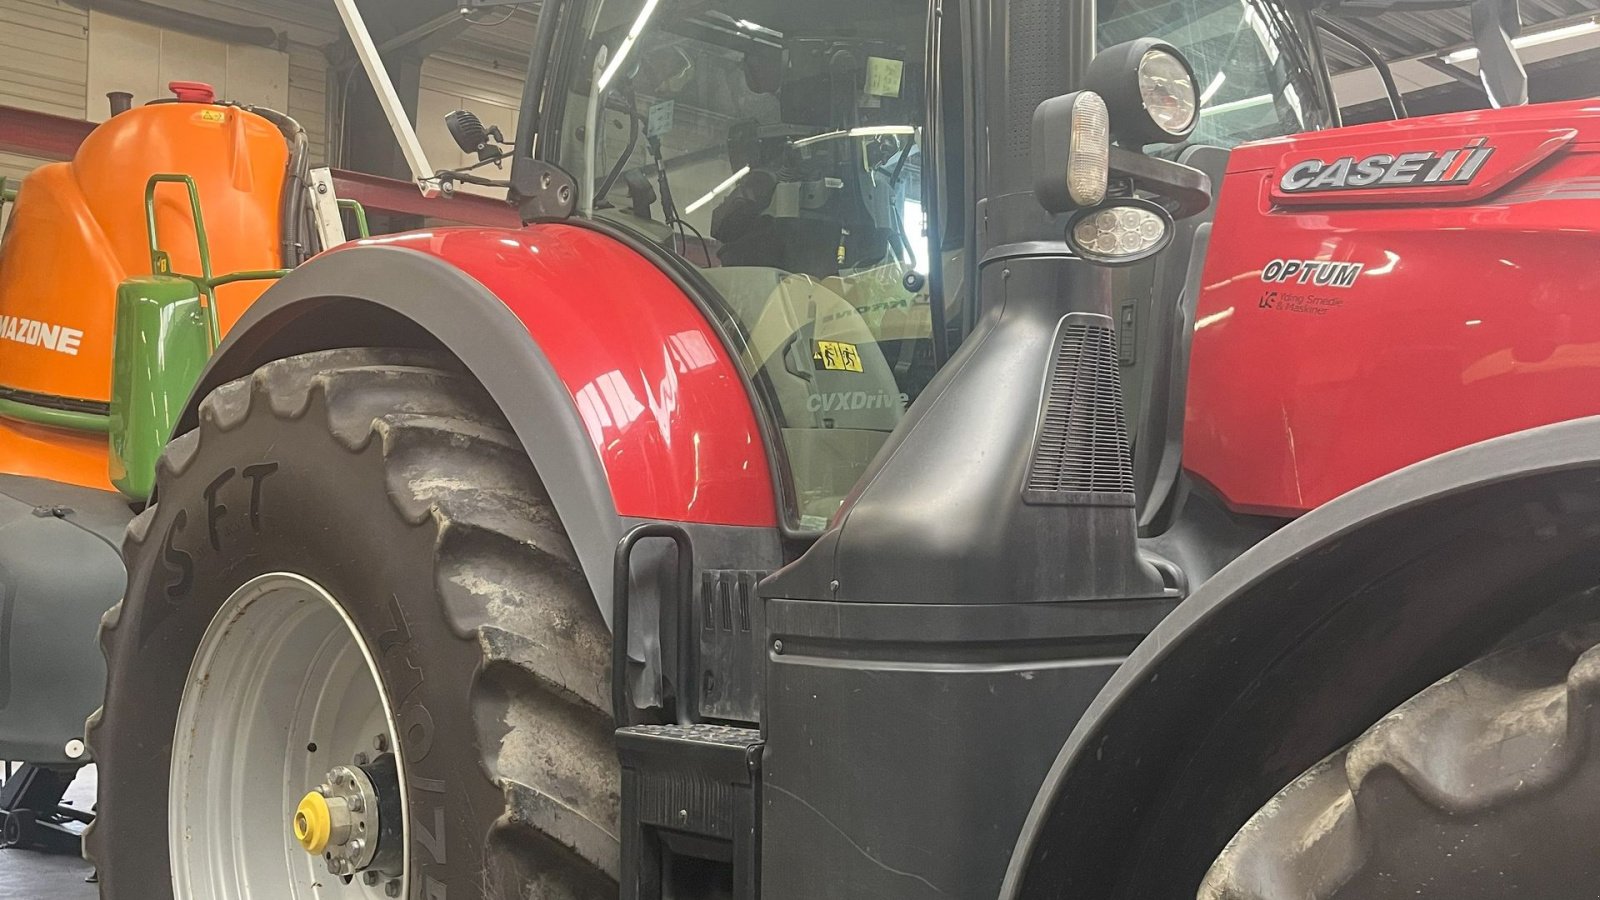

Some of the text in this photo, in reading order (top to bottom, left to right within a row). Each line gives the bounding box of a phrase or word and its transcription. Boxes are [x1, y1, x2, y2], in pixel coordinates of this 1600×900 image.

[1280, 152, 1434, 191] CASE
[1261, 259, 1364, 288] OPTUM
[806, 390, 909, 412] CVXDrive
